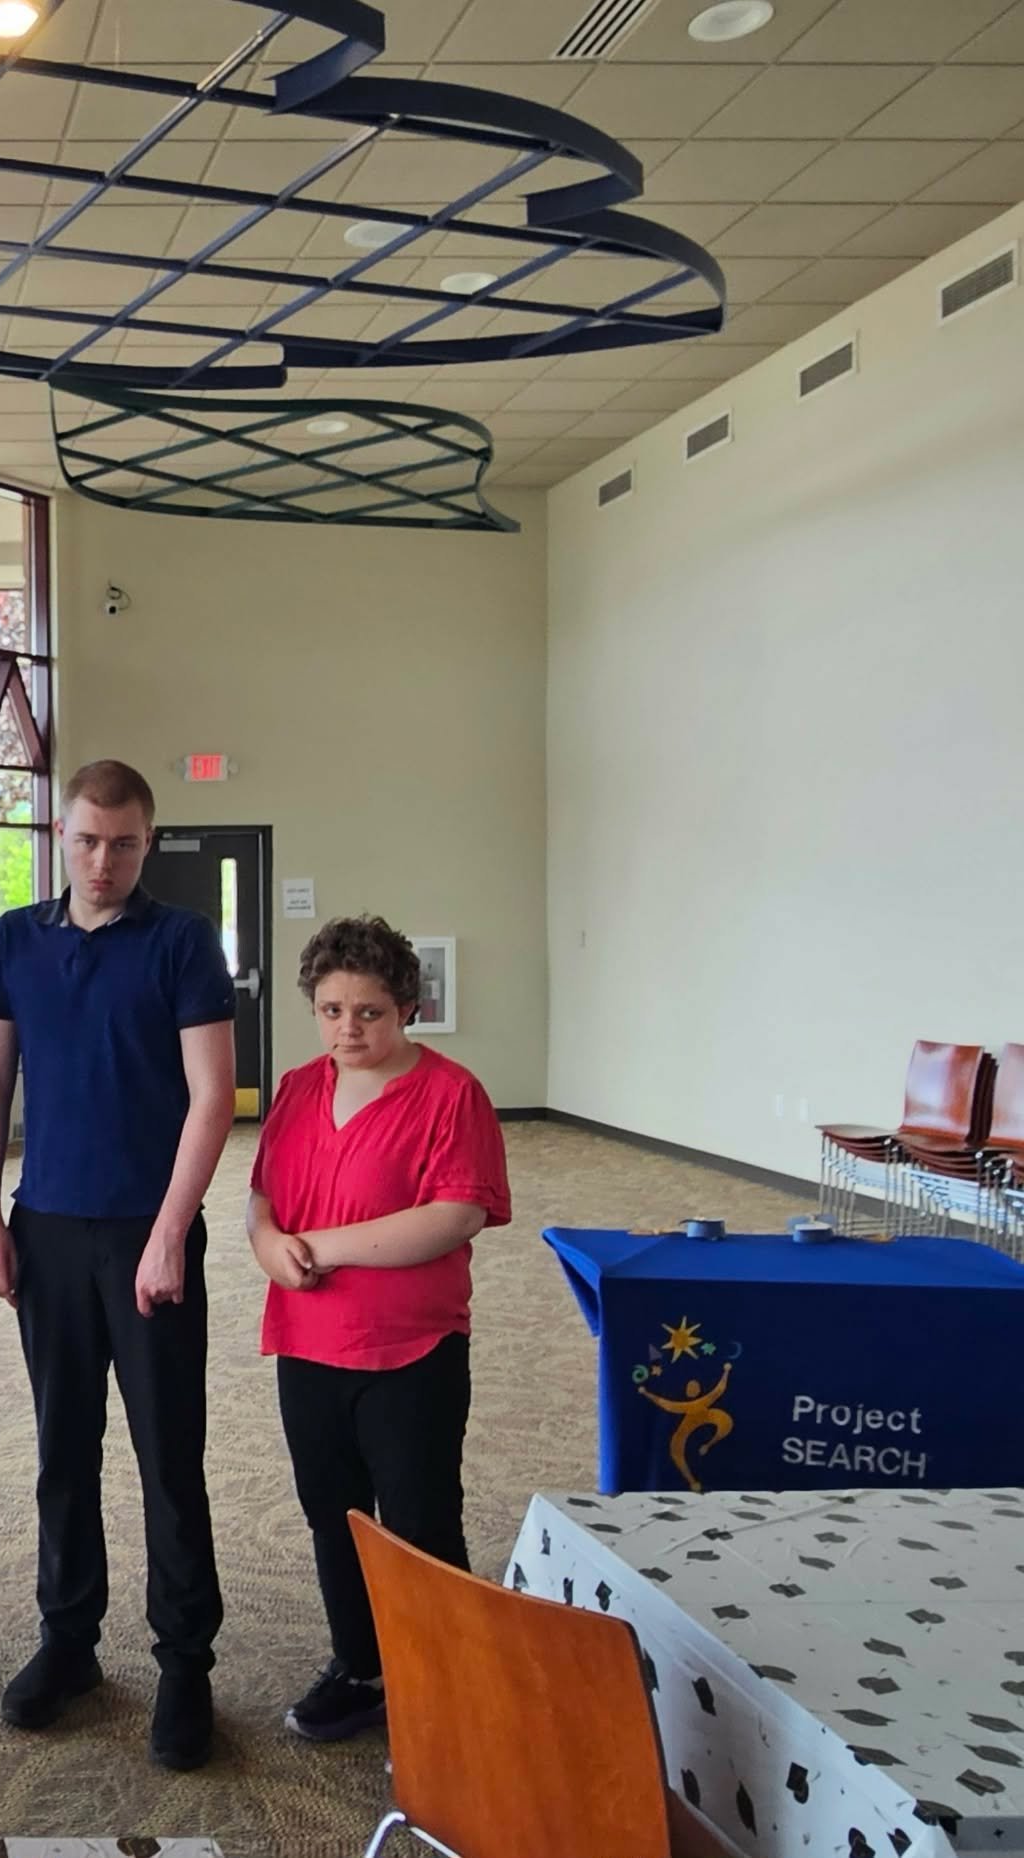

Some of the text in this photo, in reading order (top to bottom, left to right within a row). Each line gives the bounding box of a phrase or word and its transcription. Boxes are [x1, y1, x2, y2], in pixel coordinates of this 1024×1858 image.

[193, 756, 221, 778] EXIT
[792, 1395, 923, 1434] Project
[782, 1437, 927, 1479] SEARCH
